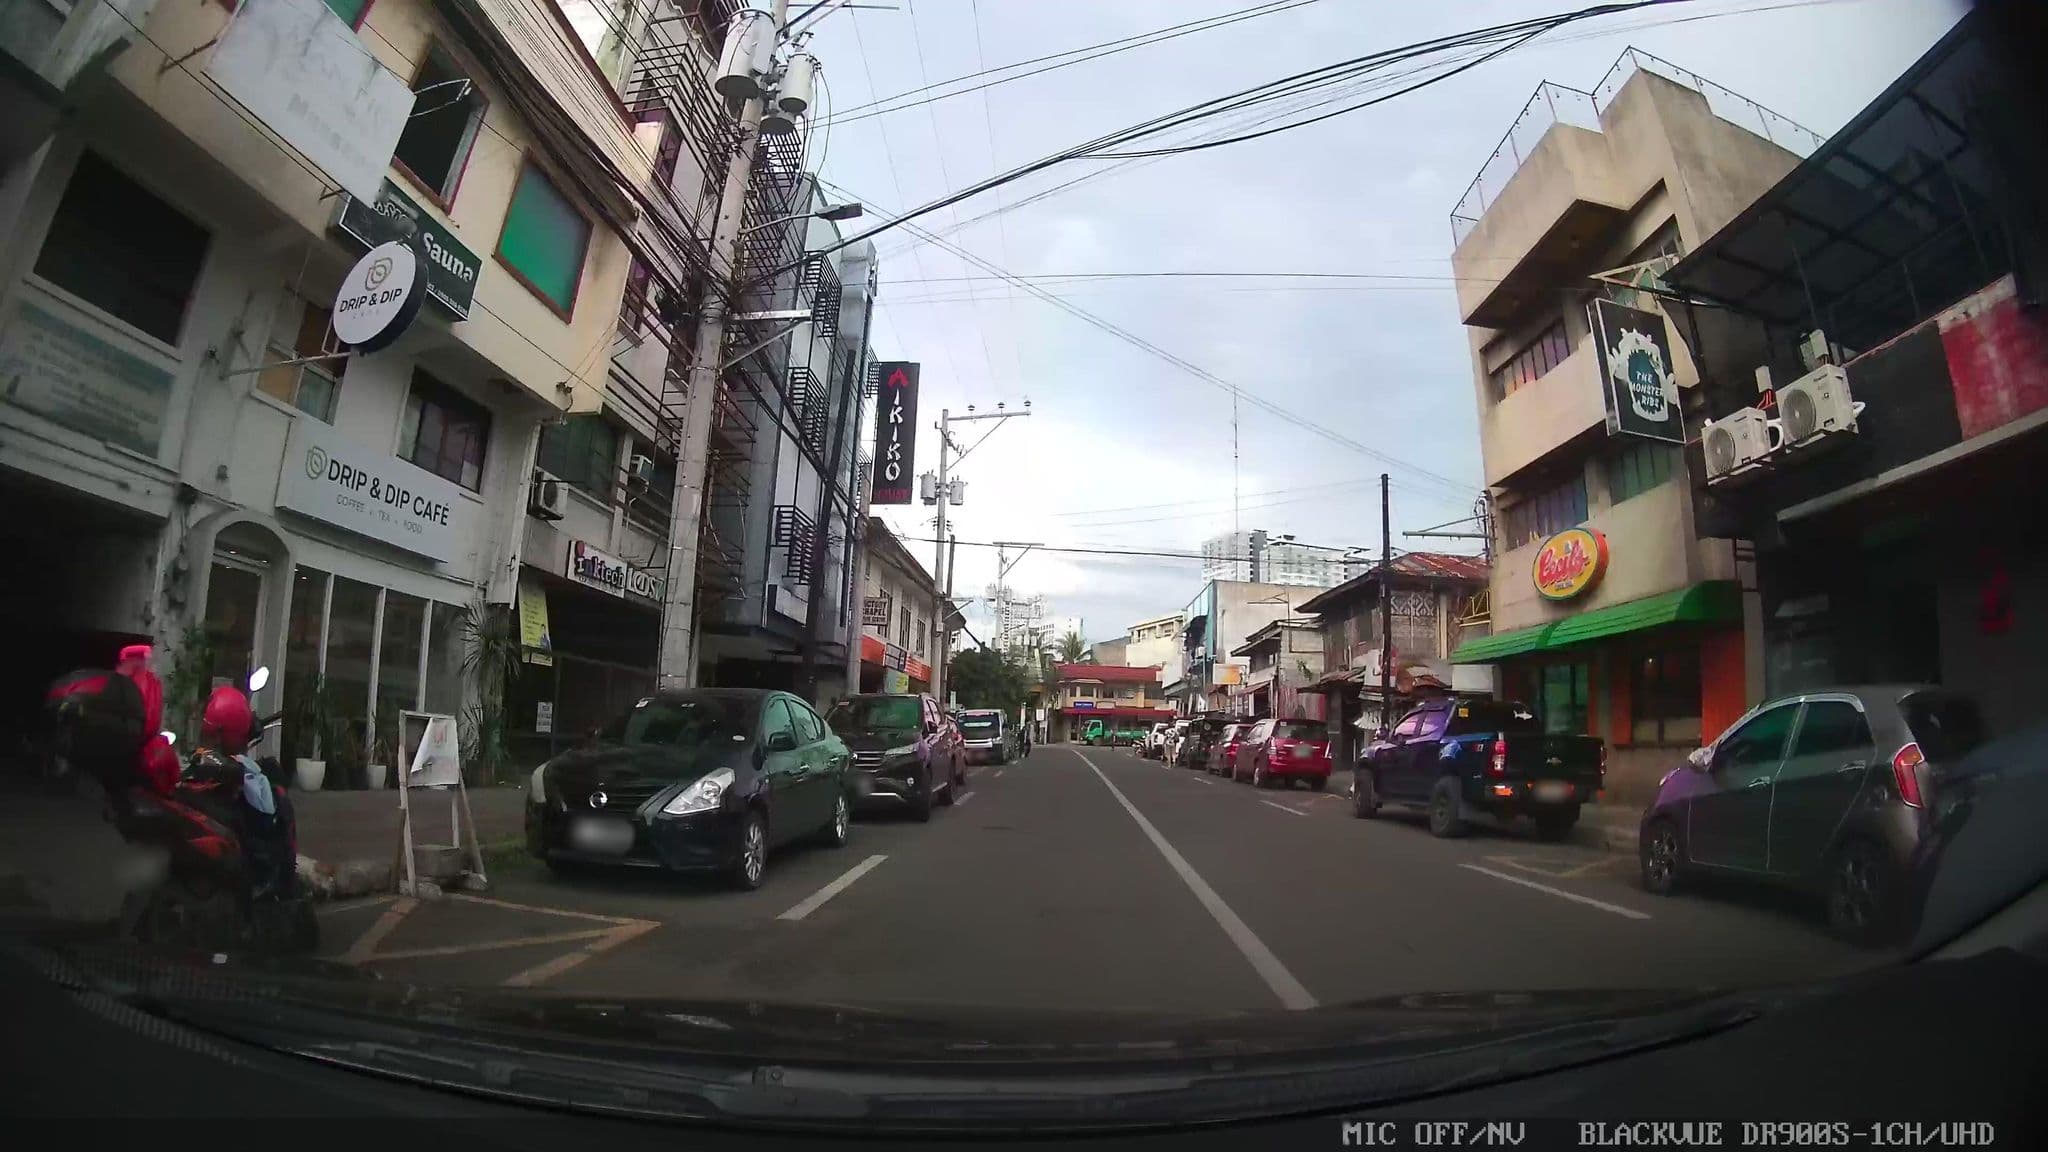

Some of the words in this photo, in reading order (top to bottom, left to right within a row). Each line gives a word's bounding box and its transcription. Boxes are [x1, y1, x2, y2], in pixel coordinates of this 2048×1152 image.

[423, 232, 474, 283] Sauna
[339, 292, 367, 313] DRIP
[368, 293, 378, 306] &
[380, 288, 403, 304] DIP
[1636, 371, 1653, 384] THE
[328, 459, 367, 492] DRIP
[369, 477, 381, 500] &
[384, 484, 410, 509] DIP
[413, 502, 450, 526] CAFÉ
[336, 494, 365, 513] COFFEE
